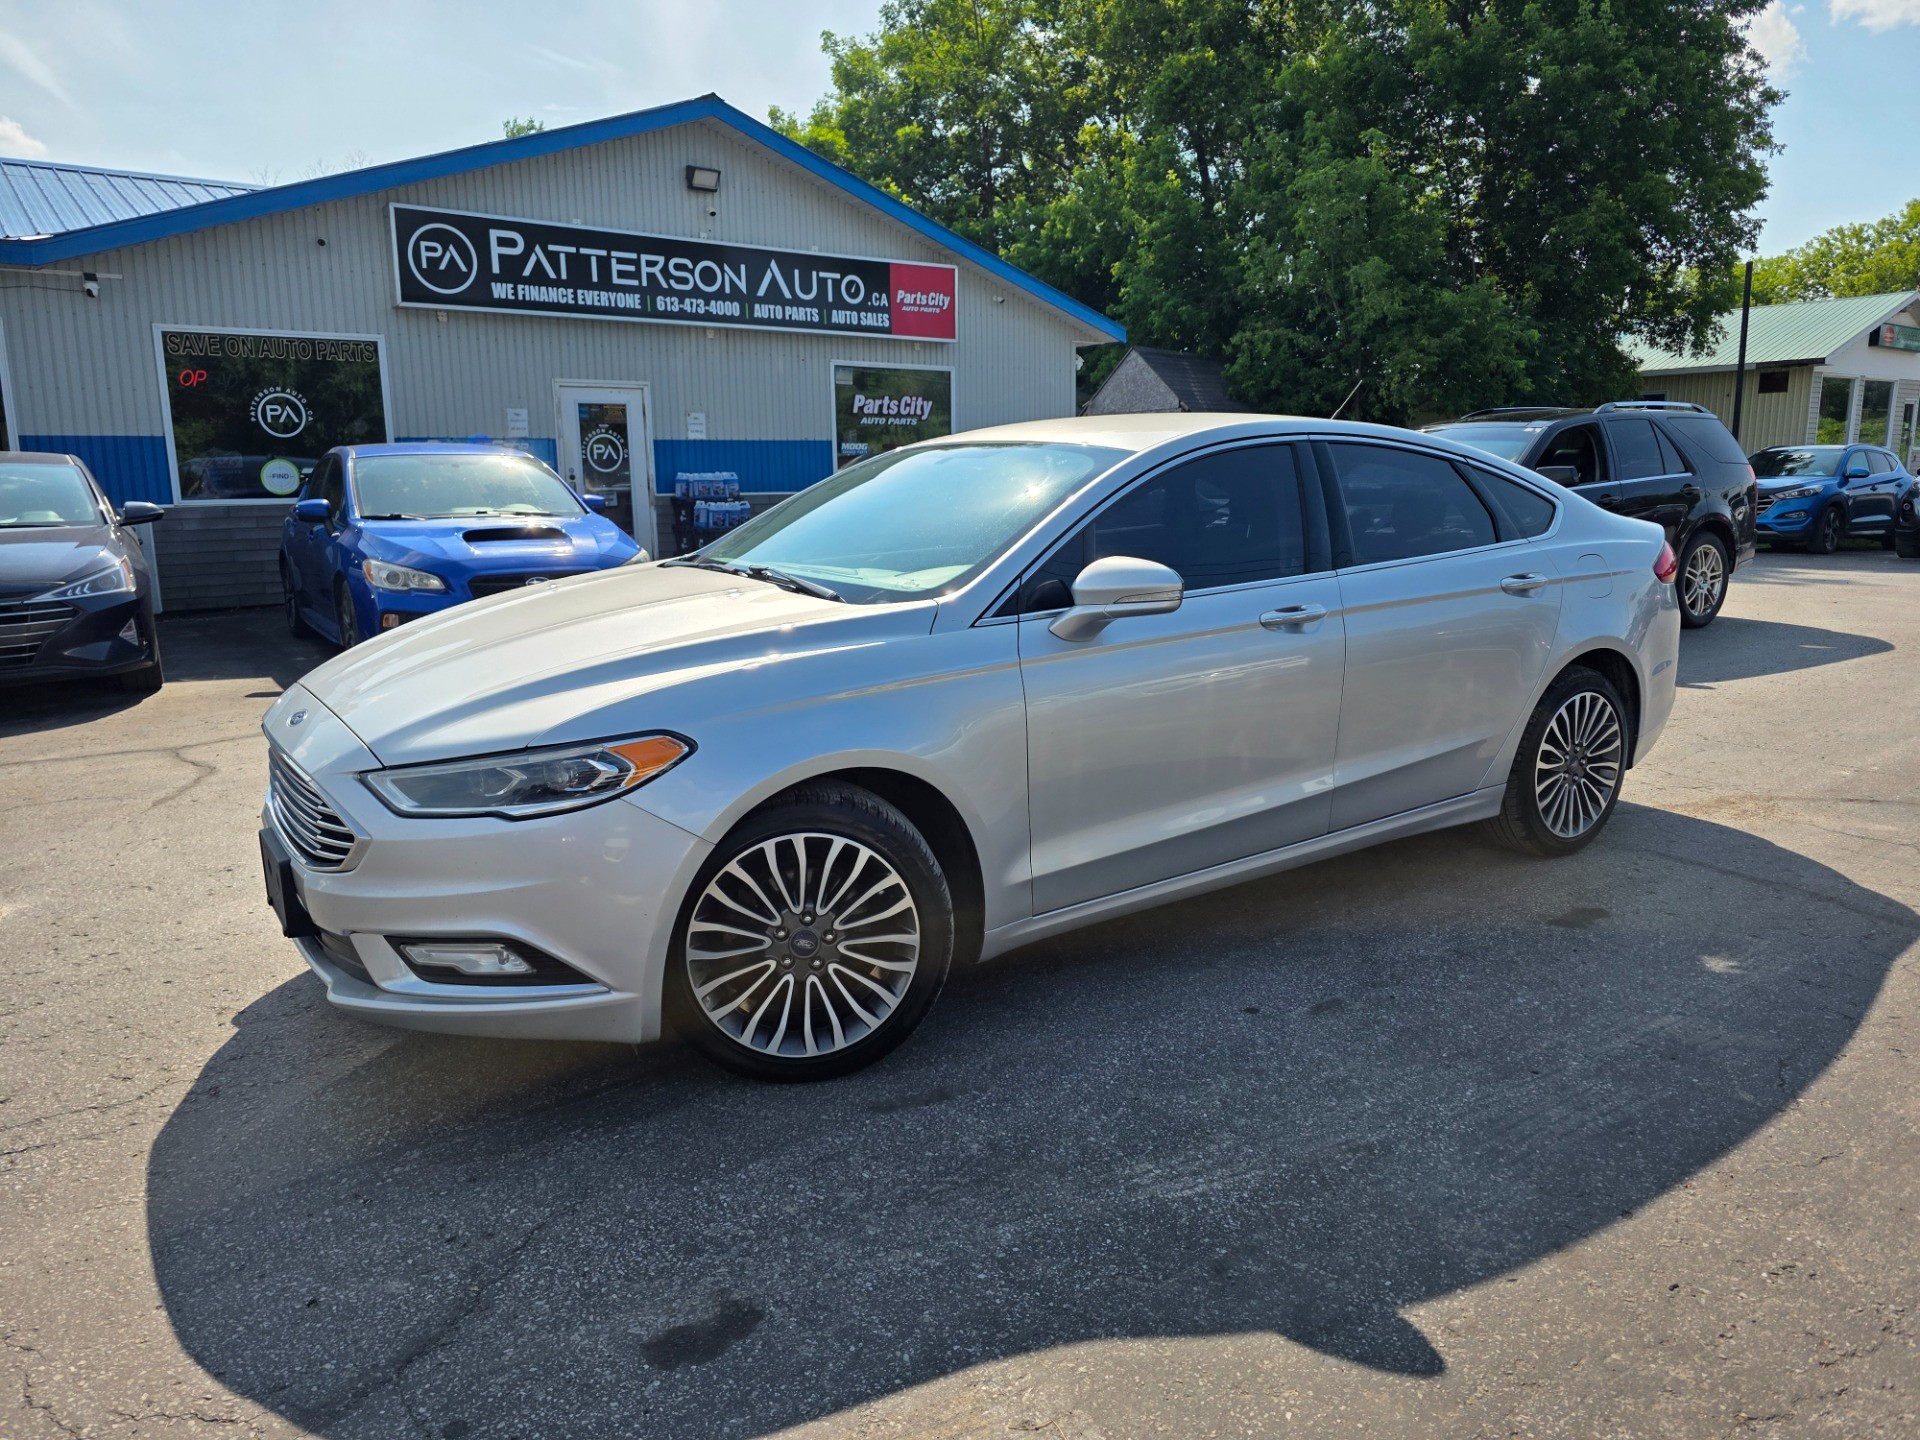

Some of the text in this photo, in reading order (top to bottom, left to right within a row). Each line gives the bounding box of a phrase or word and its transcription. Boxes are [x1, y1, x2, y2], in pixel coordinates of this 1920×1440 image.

[489, 228, 747, 295] PATTERSON
[756, 258, 865, 305] AUTO
[491, 282, 890, 327] WE FINANCE EVERYONE 613-473-4000 AUTO PARTS AUTO SALES
[920, 306, 941, 314] PARTS
[166, 334, 375, 362] SAVE ON AUTO PARTS
[250, 386, 281, 422] PATTERSON
[860, 417, 918, 426] AUTO PARTS
[582, 428, 606, 459] PATTERSON
[841, 442, 869, 451] MOOG
